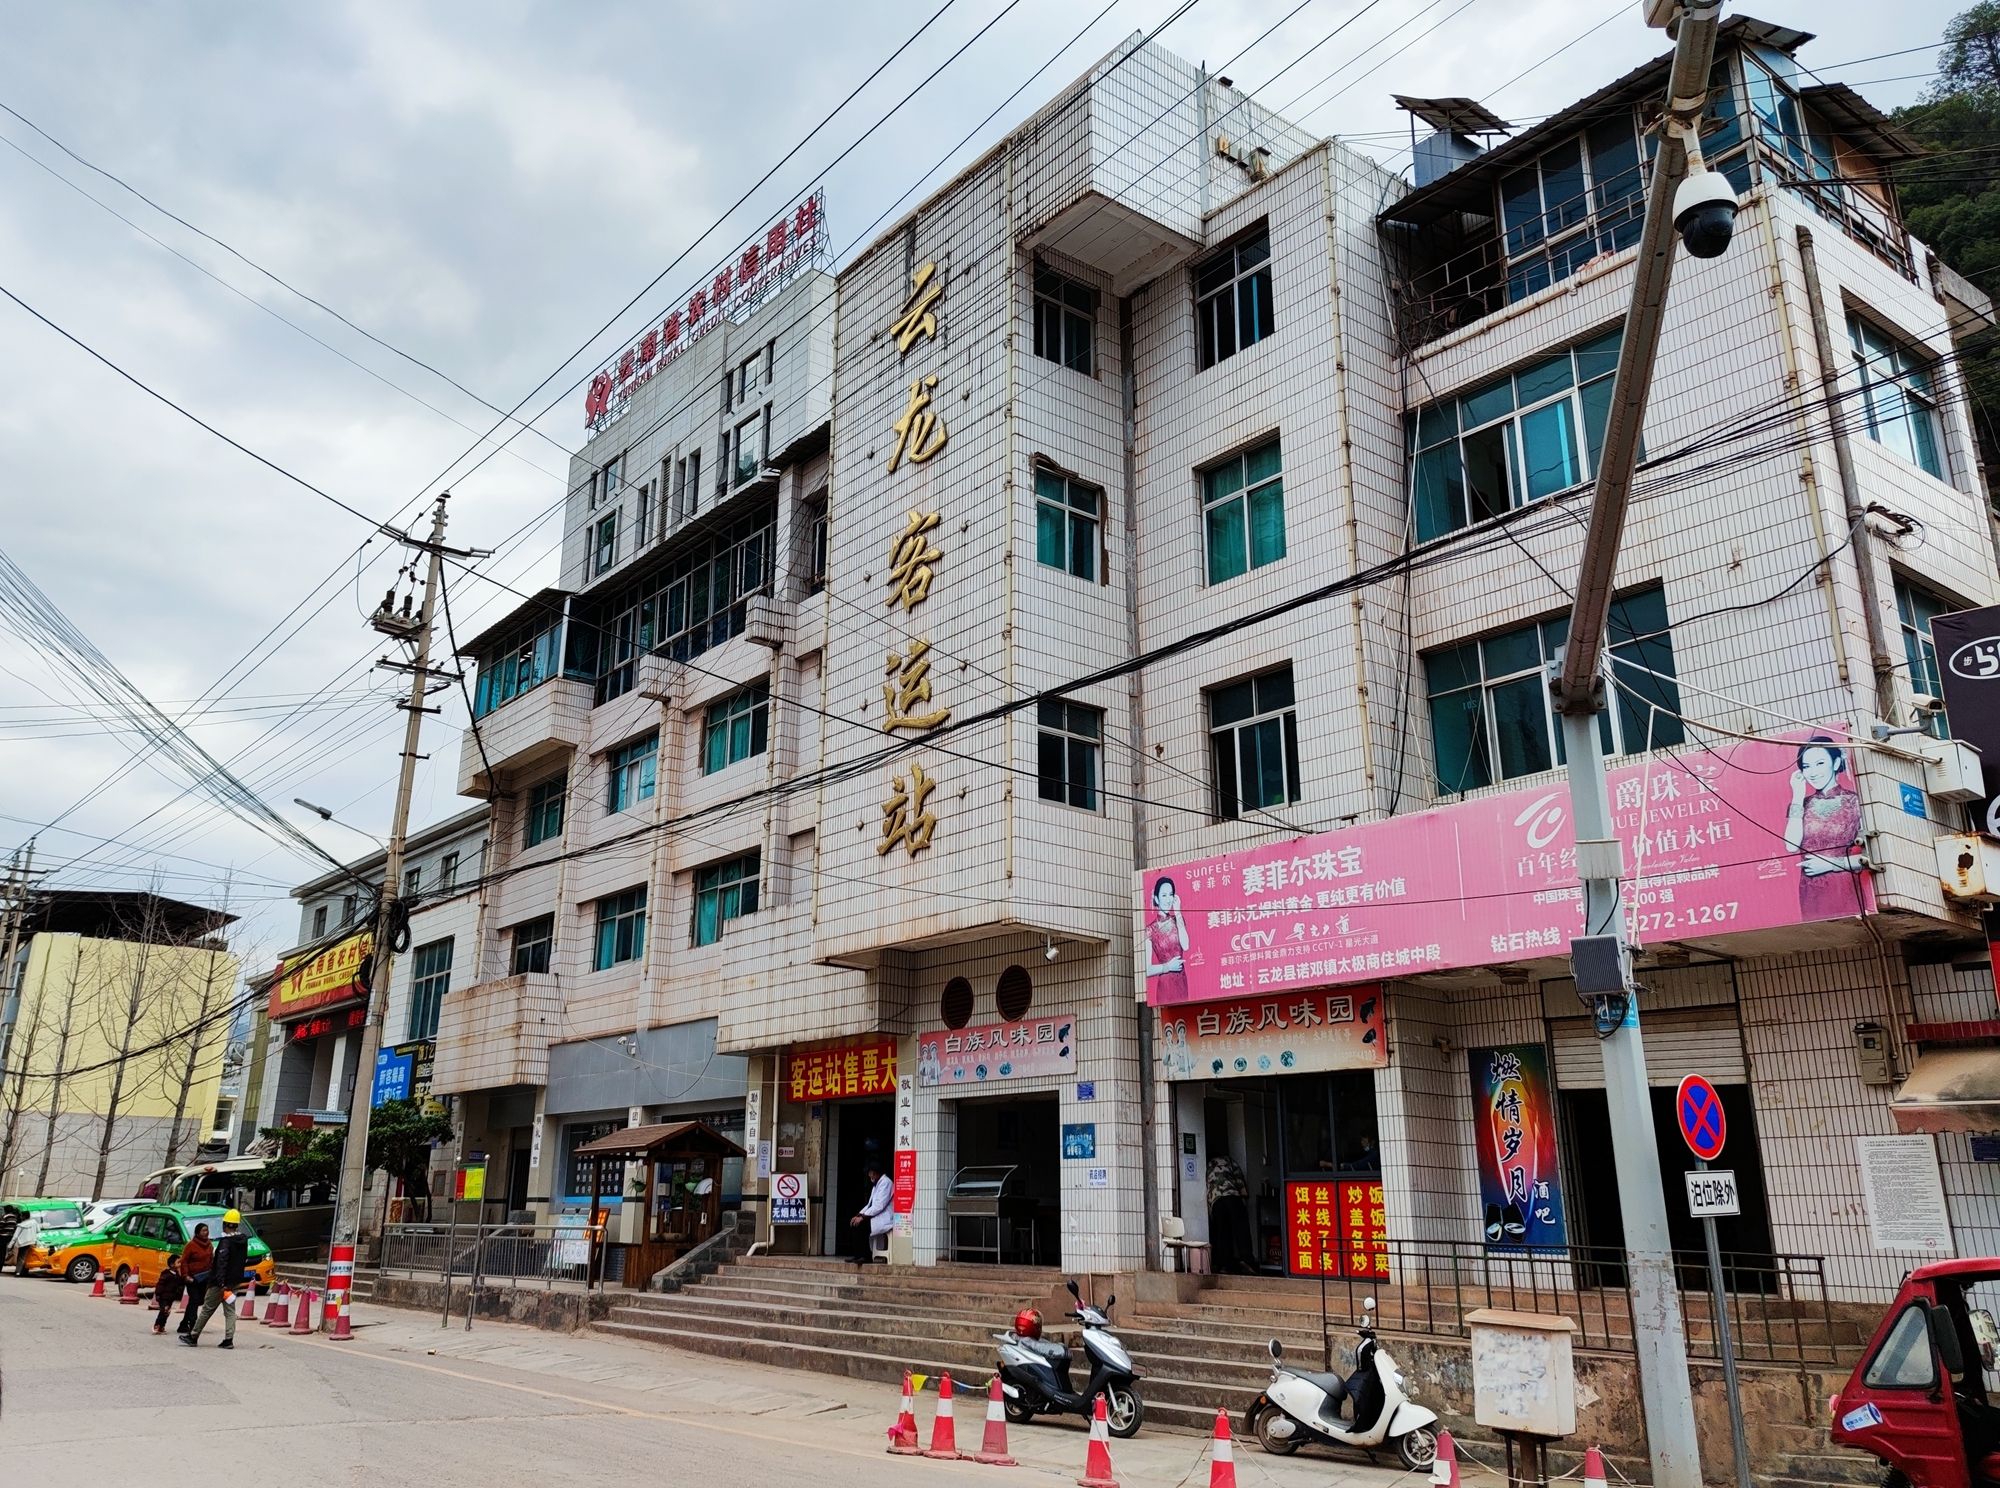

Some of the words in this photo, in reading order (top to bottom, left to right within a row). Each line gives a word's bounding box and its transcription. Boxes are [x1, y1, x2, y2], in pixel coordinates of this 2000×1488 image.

[618, 195, 819, 383] 云南省农村信用社
[877, 261, 951, 857] 云龙客运站
[1615, 764, 1720, 810] 爵珠宝
[1514, 847, 1577, 878] 百年经
[1631, 817, 1735, 858] 价值永恒
[1185, 860, 1237, 880] SUNFEEL
[1191, 875, 1232, 893] 赛菲尔
[1242, 845, 1364, 897] 赛菲尔珠宝
[1316, 877, 1407, 909] 更纯更有价值
[1230, 928, 1277, 952] CCTV
[306, 940, 370, 977] 云南省农村信
[1196, 994, 1354, 1036] 白族风味园
[943, 1021, 1056, 1054] 白族风味园
[791, 1045, 897, 1099] 客运站售票大
[899, 1078, 912, 1147] 敬业奉献
[1490, 1051, 1528, 1205] 燃情岁月
[1295, 1186, 1330, 1205] 饵丝
[1347, 1185, 1384, 1205] 炒饭
[1532, 1178, 1556, 1225] 酒吧
[1690, 1179, 1736, 1207] 泊位除外
[772, 1207, 806, 1219] 无烟单位
[1296, 1207, 1332, 1227] 米线
[1349, 1207, 1385, 1227] 盖饭
[1298, 1251, 1333, 1271] 面条
[1351, 1252, 1390, 1272] 炒菜
